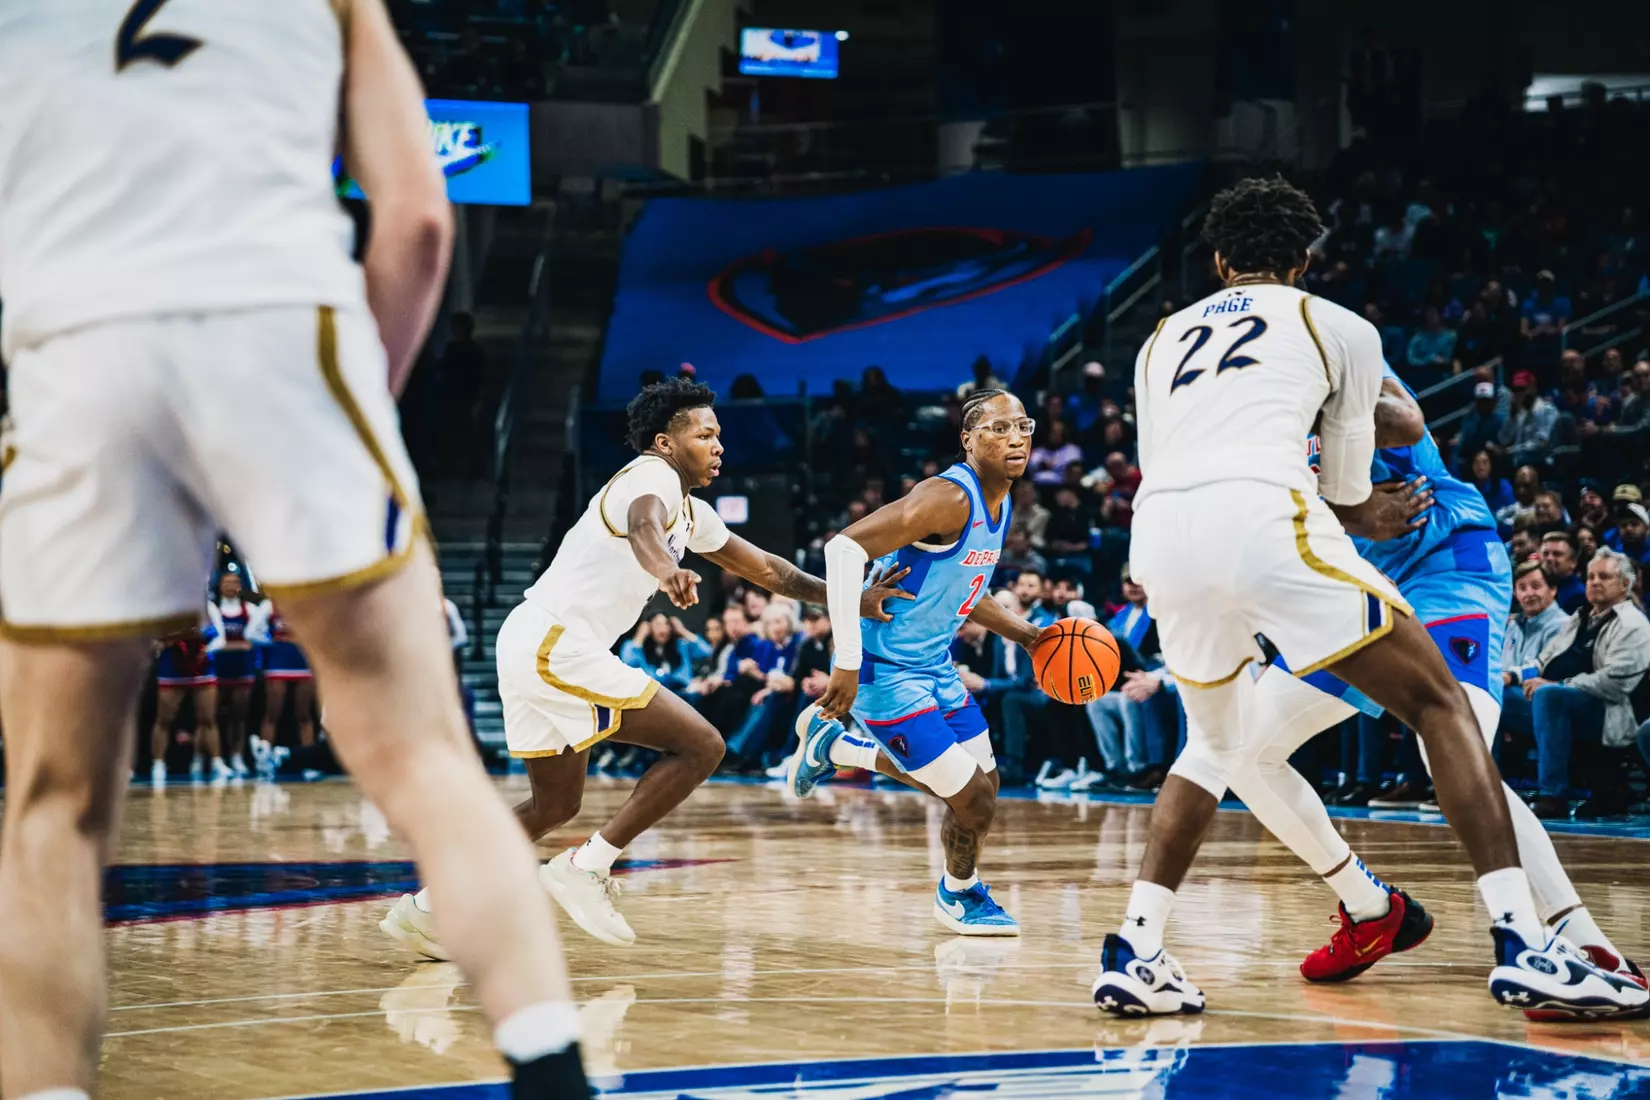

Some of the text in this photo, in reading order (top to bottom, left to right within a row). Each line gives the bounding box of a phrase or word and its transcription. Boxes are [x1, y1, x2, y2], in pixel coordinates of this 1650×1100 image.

[1202, 297, 1254, 318] PAGE
[1170, 315, 1268, 396] 22
[956, 573, 985, 615] 2
